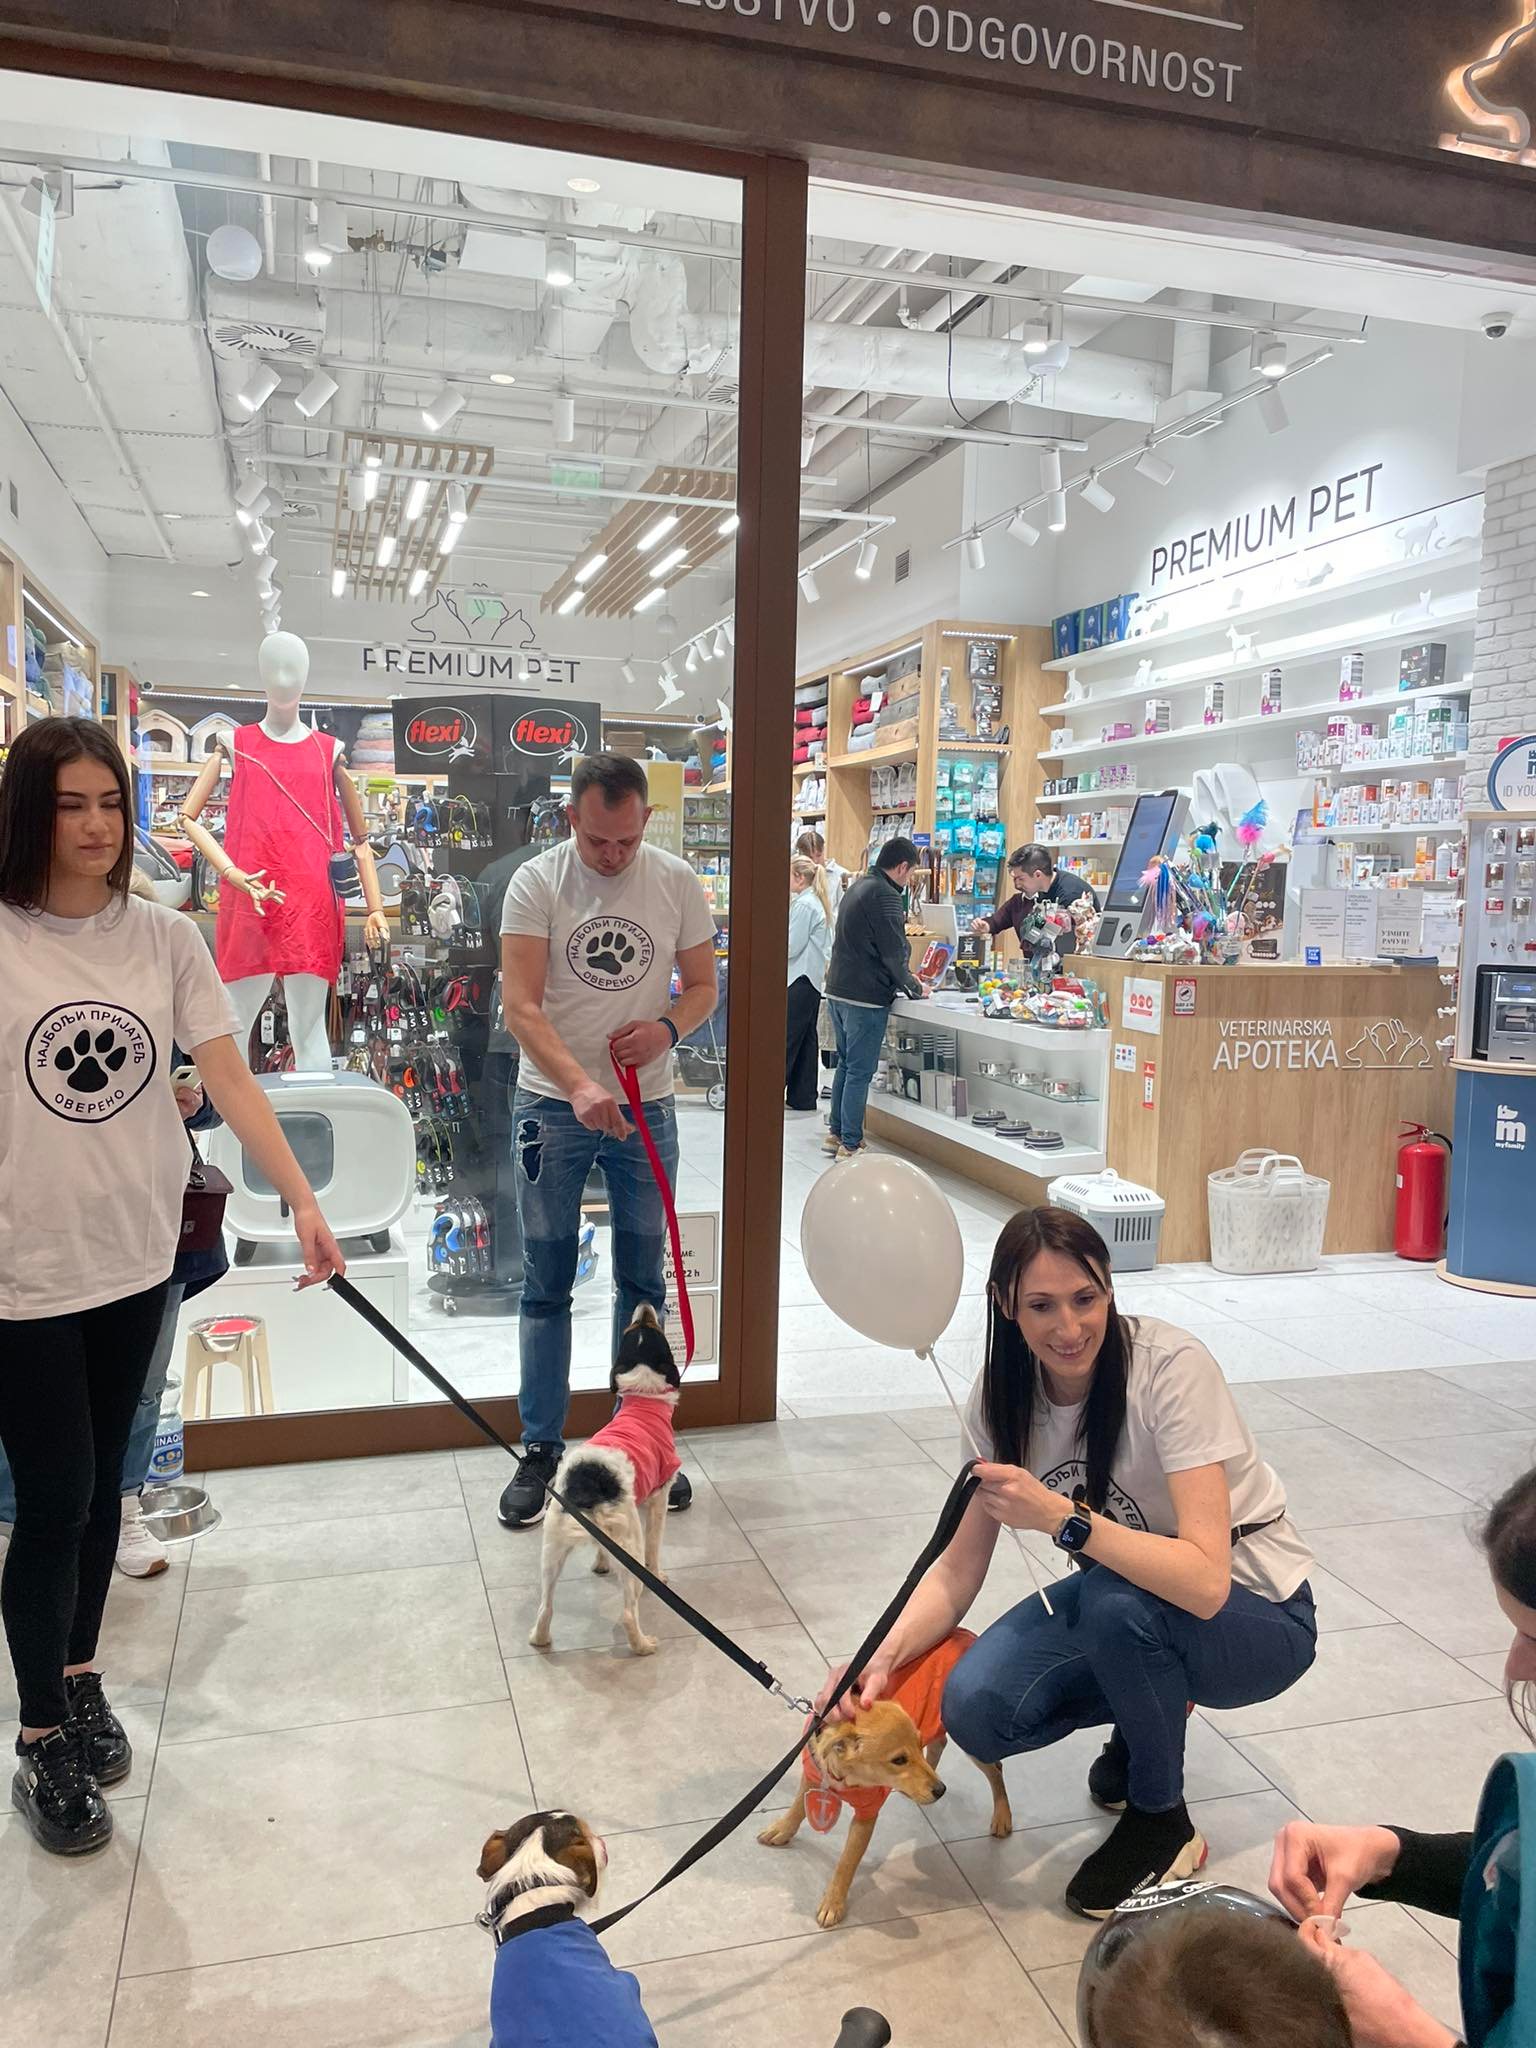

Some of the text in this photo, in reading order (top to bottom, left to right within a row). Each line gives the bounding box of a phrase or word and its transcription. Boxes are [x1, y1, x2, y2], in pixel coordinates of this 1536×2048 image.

[912, 5, 1242, 102] ODGOVORNOST
[1150, 463, 1383, 586] PREMIUM PET
[363, 648, 581, 683] PREMIUM PET
[410, 719, 461, 743] flexi
[516, 720, 572, 744] flexi
[570, 920, 651, 967] НАЈБОЉИ ПРИЈАТЕЉ
[583, 971, 635, 987] ОВЕРЕНО
[37, 1010, 145, 1067] НАЈБОЉИ ПРИЈАТЕЉ
[1219, 1019, 1333, 1037] VETERINARSKA
[1213, 1039, 1340, 1070] APOTEKA
[54, 1089, 125, 1113] ОВЕРЕНО
[1046, 1465, 1080, 1488] ОЉИ
